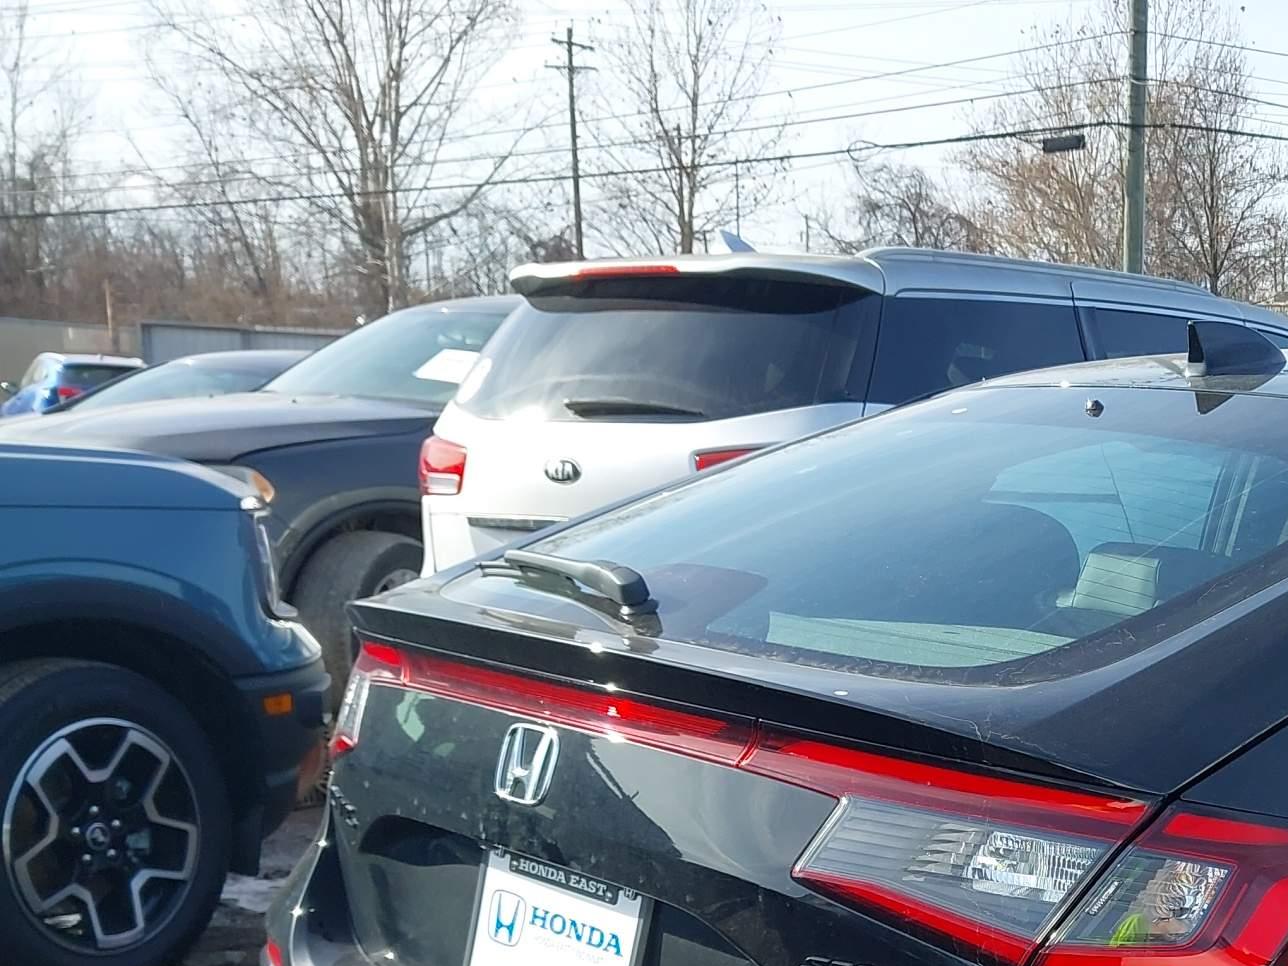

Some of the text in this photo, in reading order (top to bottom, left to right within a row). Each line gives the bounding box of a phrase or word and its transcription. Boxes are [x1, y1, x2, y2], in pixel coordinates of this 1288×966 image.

[519, 858, 607, 897] HONDA EAST
[529, 905, 623, 957] HONDA
